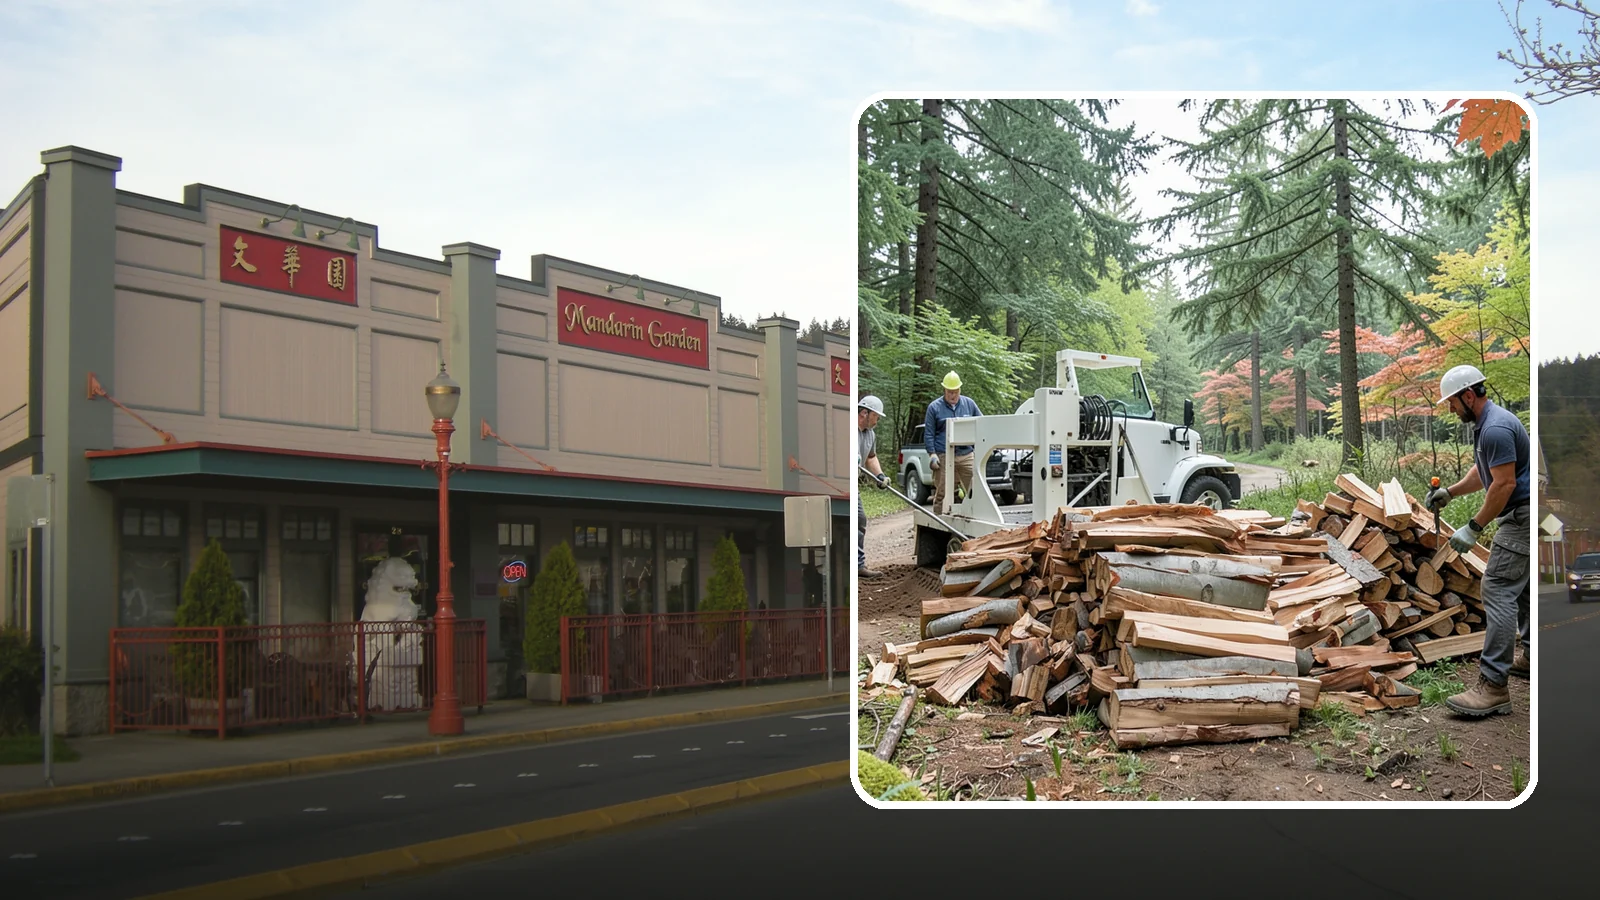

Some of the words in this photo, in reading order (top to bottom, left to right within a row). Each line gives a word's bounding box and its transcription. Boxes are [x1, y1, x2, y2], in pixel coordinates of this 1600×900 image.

[231, 236, 346, 291] 文華園
[564, 302, 644, 341] Mandarin
[647, 320, 701, 352] Garden
[834, 363, 846, 386] 文
[503, 565, 527, 578] OPEN
